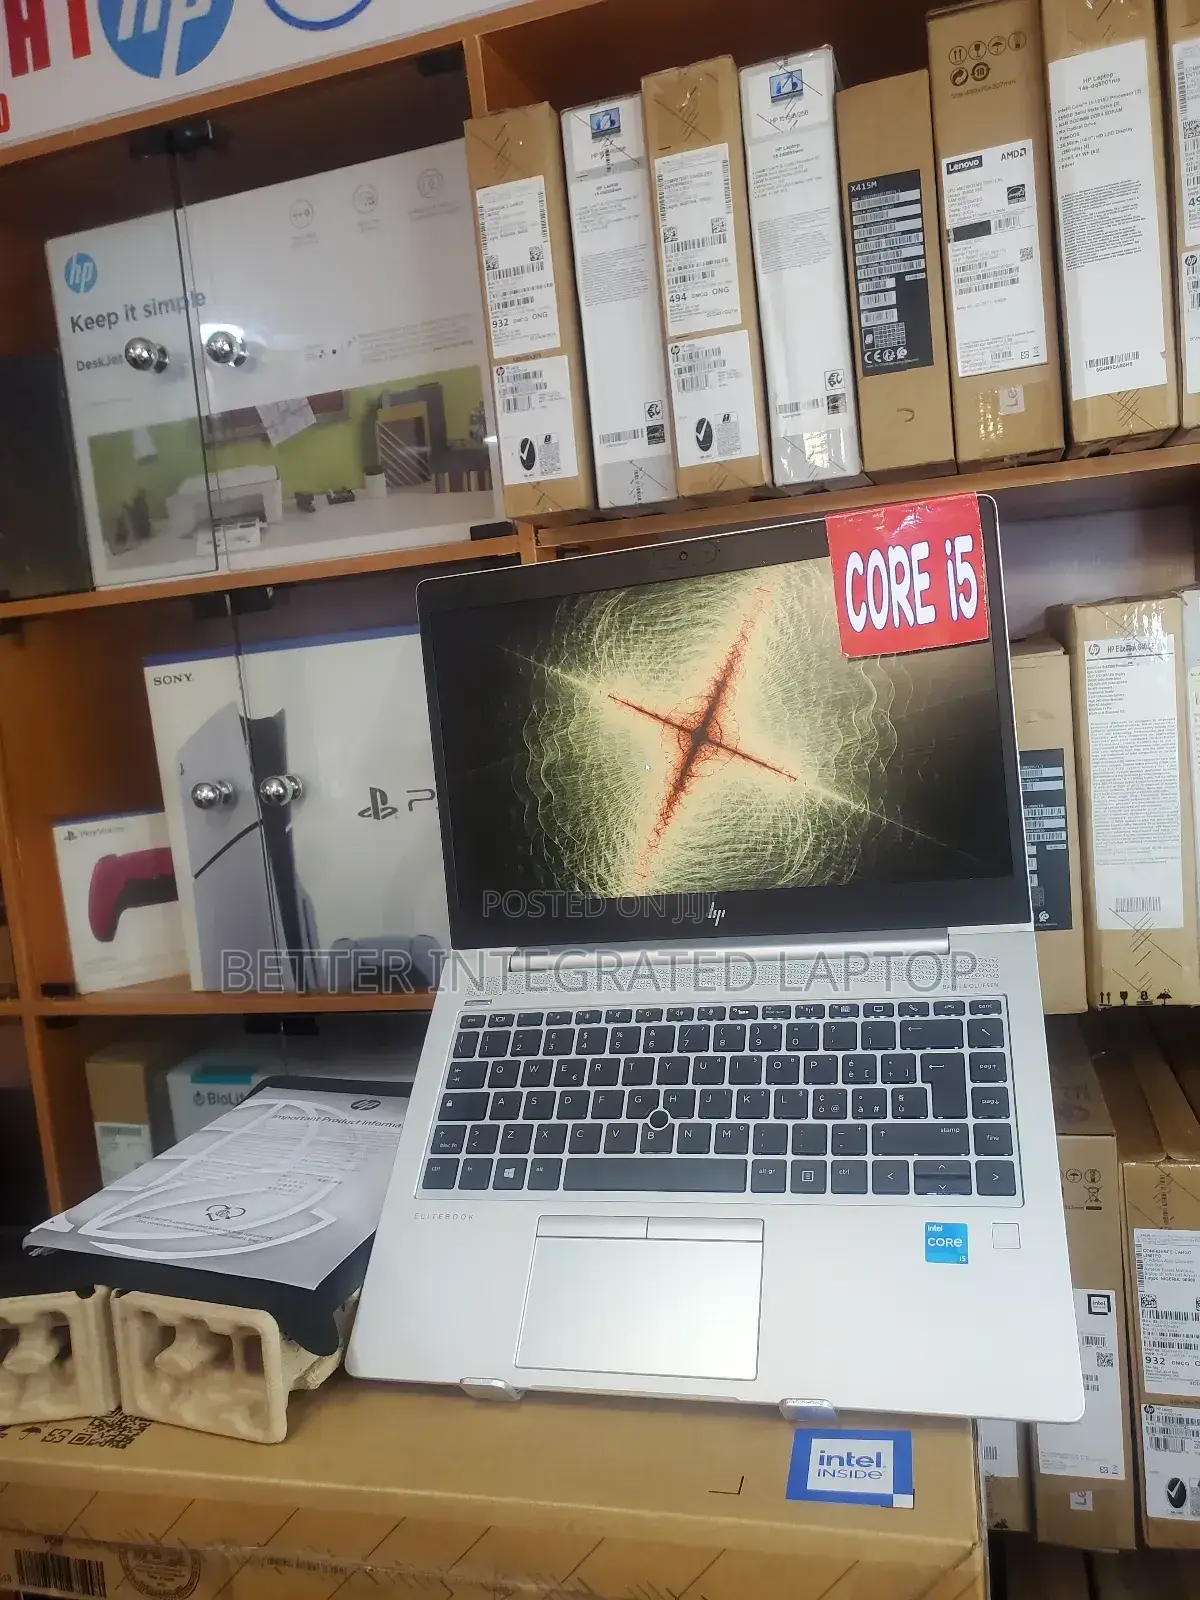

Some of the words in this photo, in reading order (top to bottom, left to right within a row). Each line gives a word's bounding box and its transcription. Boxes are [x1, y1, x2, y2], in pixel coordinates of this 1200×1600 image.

[948, 159, 979, 172] Lenovo
[1001, 150, 1019, 161] AMD
[850, 181, 877, 192] X415M
[69, 254, 95, 294] hp
[669, 293, 687, 303] 494
[712, 287, 729, 295] ONG
[70, 311, 119, 333] Keep
[124, 304, 137, 321] it
[143, 291, 206, 318] simple
[492, 319, 509, 328] 932
[76, 353, 124, 371] DeskJet
[844, 541, 936, 633] CORE
[946, 534, 979, 622] i5
[153, 672, 194, 686] SONY
[496, 1066, 504, 1074] Q
[272, 1114, 320, 1122] Important
[322, 1116, 359, 1125] Product
[1145, 1356, 1165, 1366] 932
[818, 1450, 882, 1468] intel
